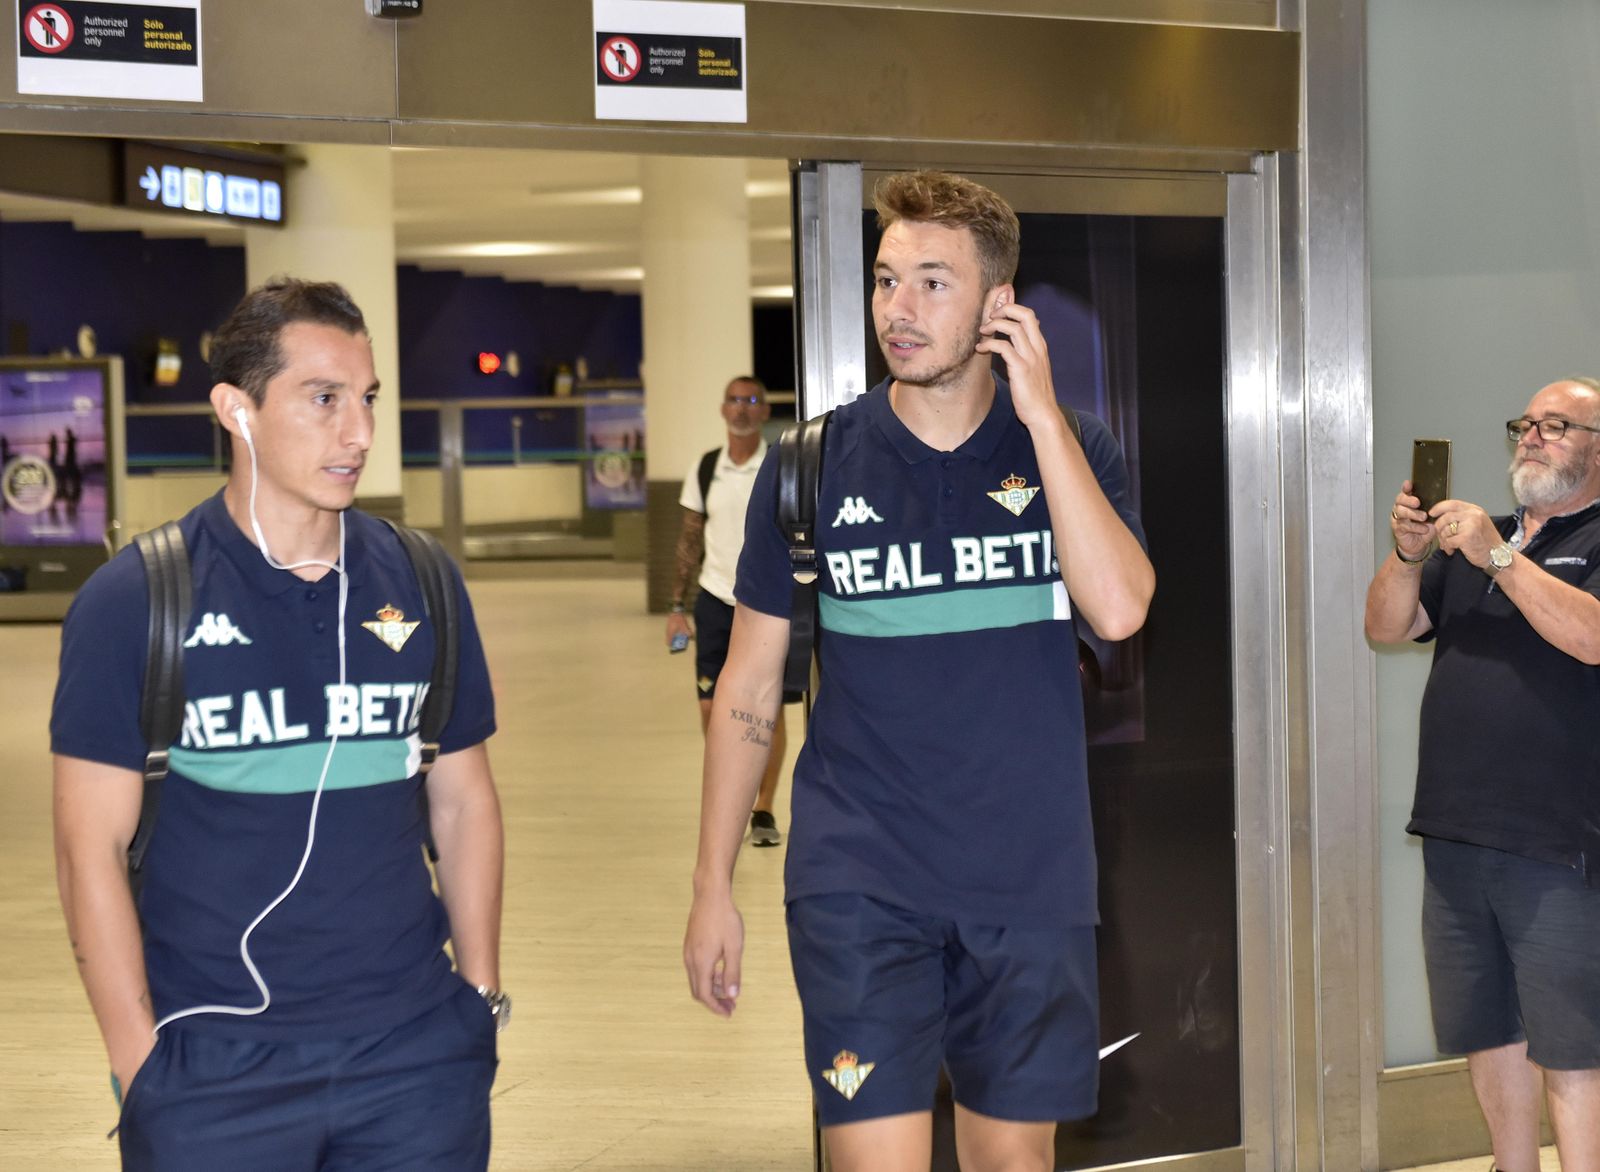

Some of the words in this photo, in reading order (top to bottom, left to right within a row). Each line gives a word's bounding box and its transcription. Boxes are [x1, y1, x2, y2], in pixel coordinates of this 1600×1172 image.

[84, 15, 128, 28] Authorized
[84, 27, 125, 38] personnel
[144, 31, 183, 41] personal
[85, 37, 102, 47] only
[144, 40, 192, 51] autorizado
[649, 47, 686, 57] Authorized
[649, 57, 684, 66] personnel
[698, 58, 731, 68] personal
[649, 66, 665, 76] only
[698, 67, 738, 77] autorizado
[824, 542, 943, 595] REAL
[951, 530, 1060, 583] BETI
[180, 687, 309, 749] REAL
